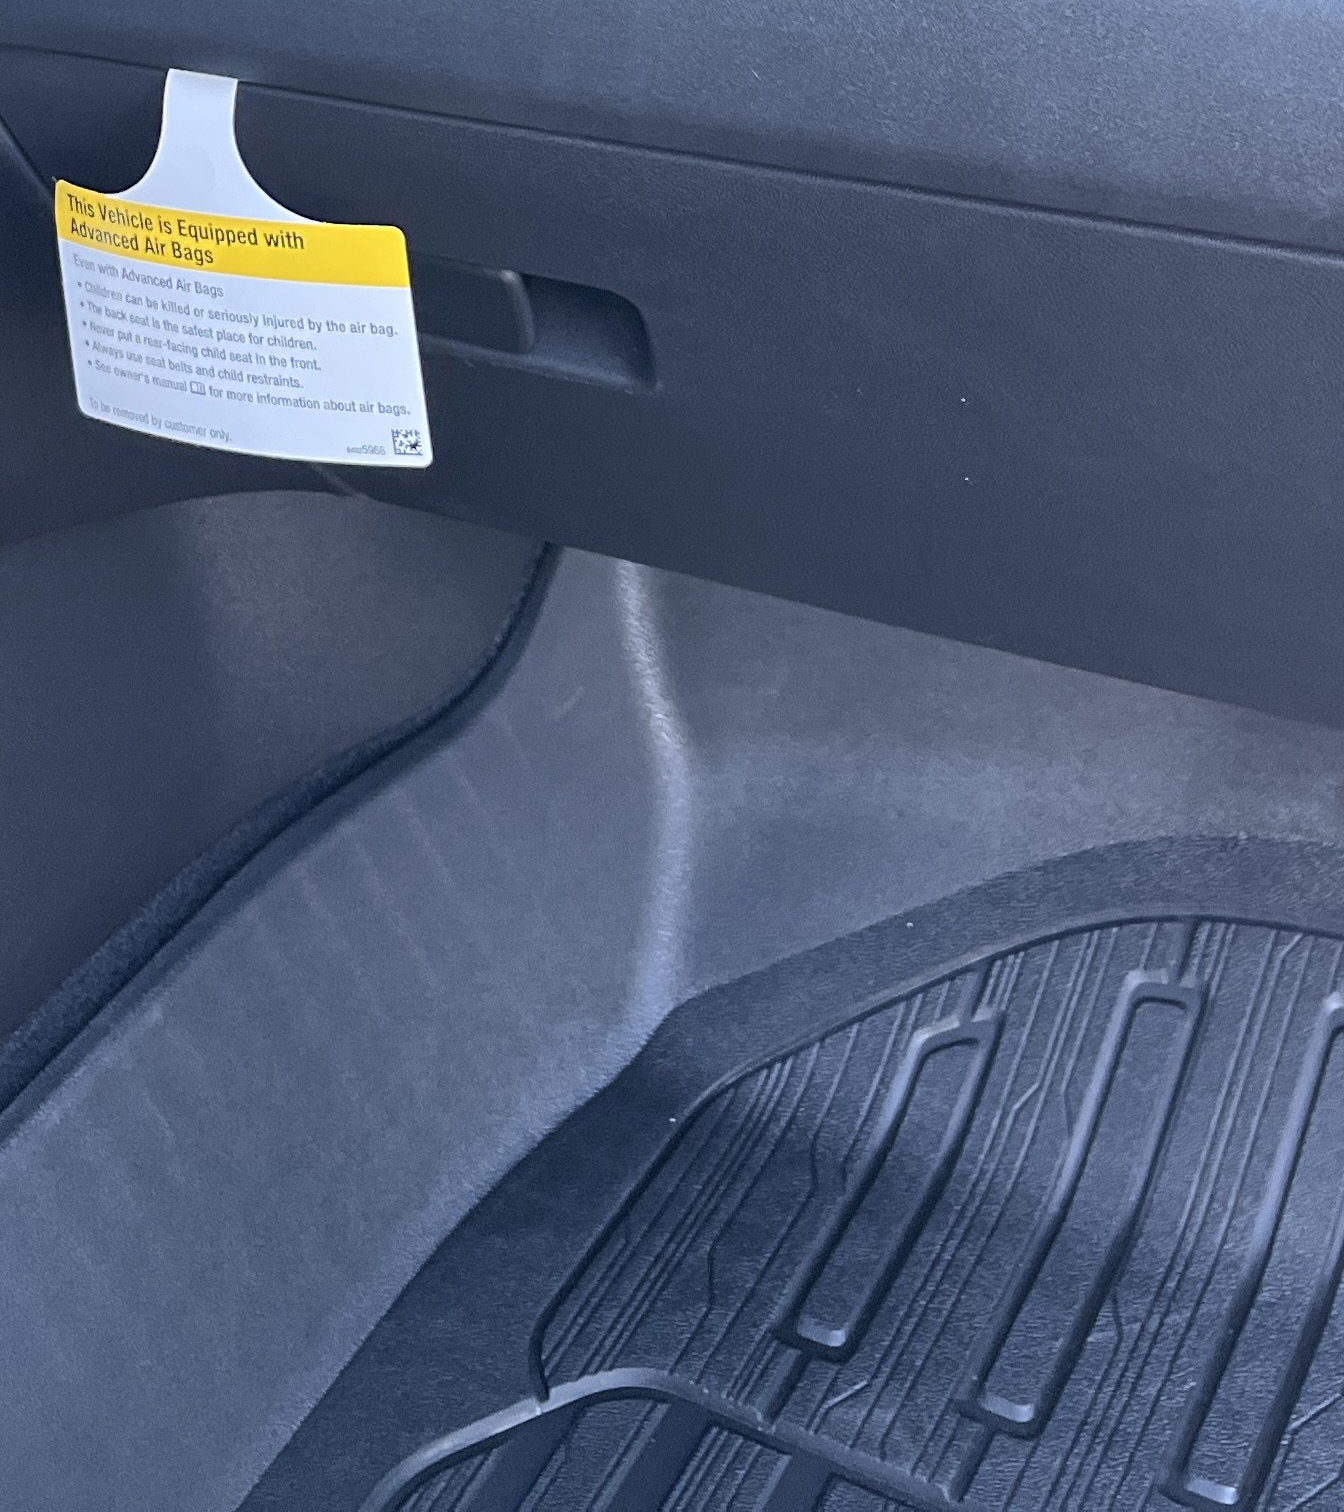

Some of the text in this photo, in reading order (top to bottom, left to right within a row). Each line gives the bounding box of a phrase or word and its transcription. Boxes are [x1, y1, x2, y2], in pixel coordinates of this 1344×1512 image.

[67, 193, 305, 250] This Vehicle is Equipped with
[71, 217, 214, 266] Advanced Air Bags
[98, 263, 119, 278] with
[122, 267, 173, 289] Advanced
[176, 279, 192, 293] Air
[194, 281, 225, 299] Bags
[84, 280, 399, 338] Children can be killed or seriously injured by the air bag.
[87, 301, 318, 351] The back seat is the safest place for children.
[90, 320, 322, 371] Never put a rear-facing child seat in the front.
[92, 340, 305, 389] Always use seat belts and child restraints.
[95, 359, 411, 417] See owner's manual for more information about air bags.
[88, 396, 233, 443] To be removed by customer only.
